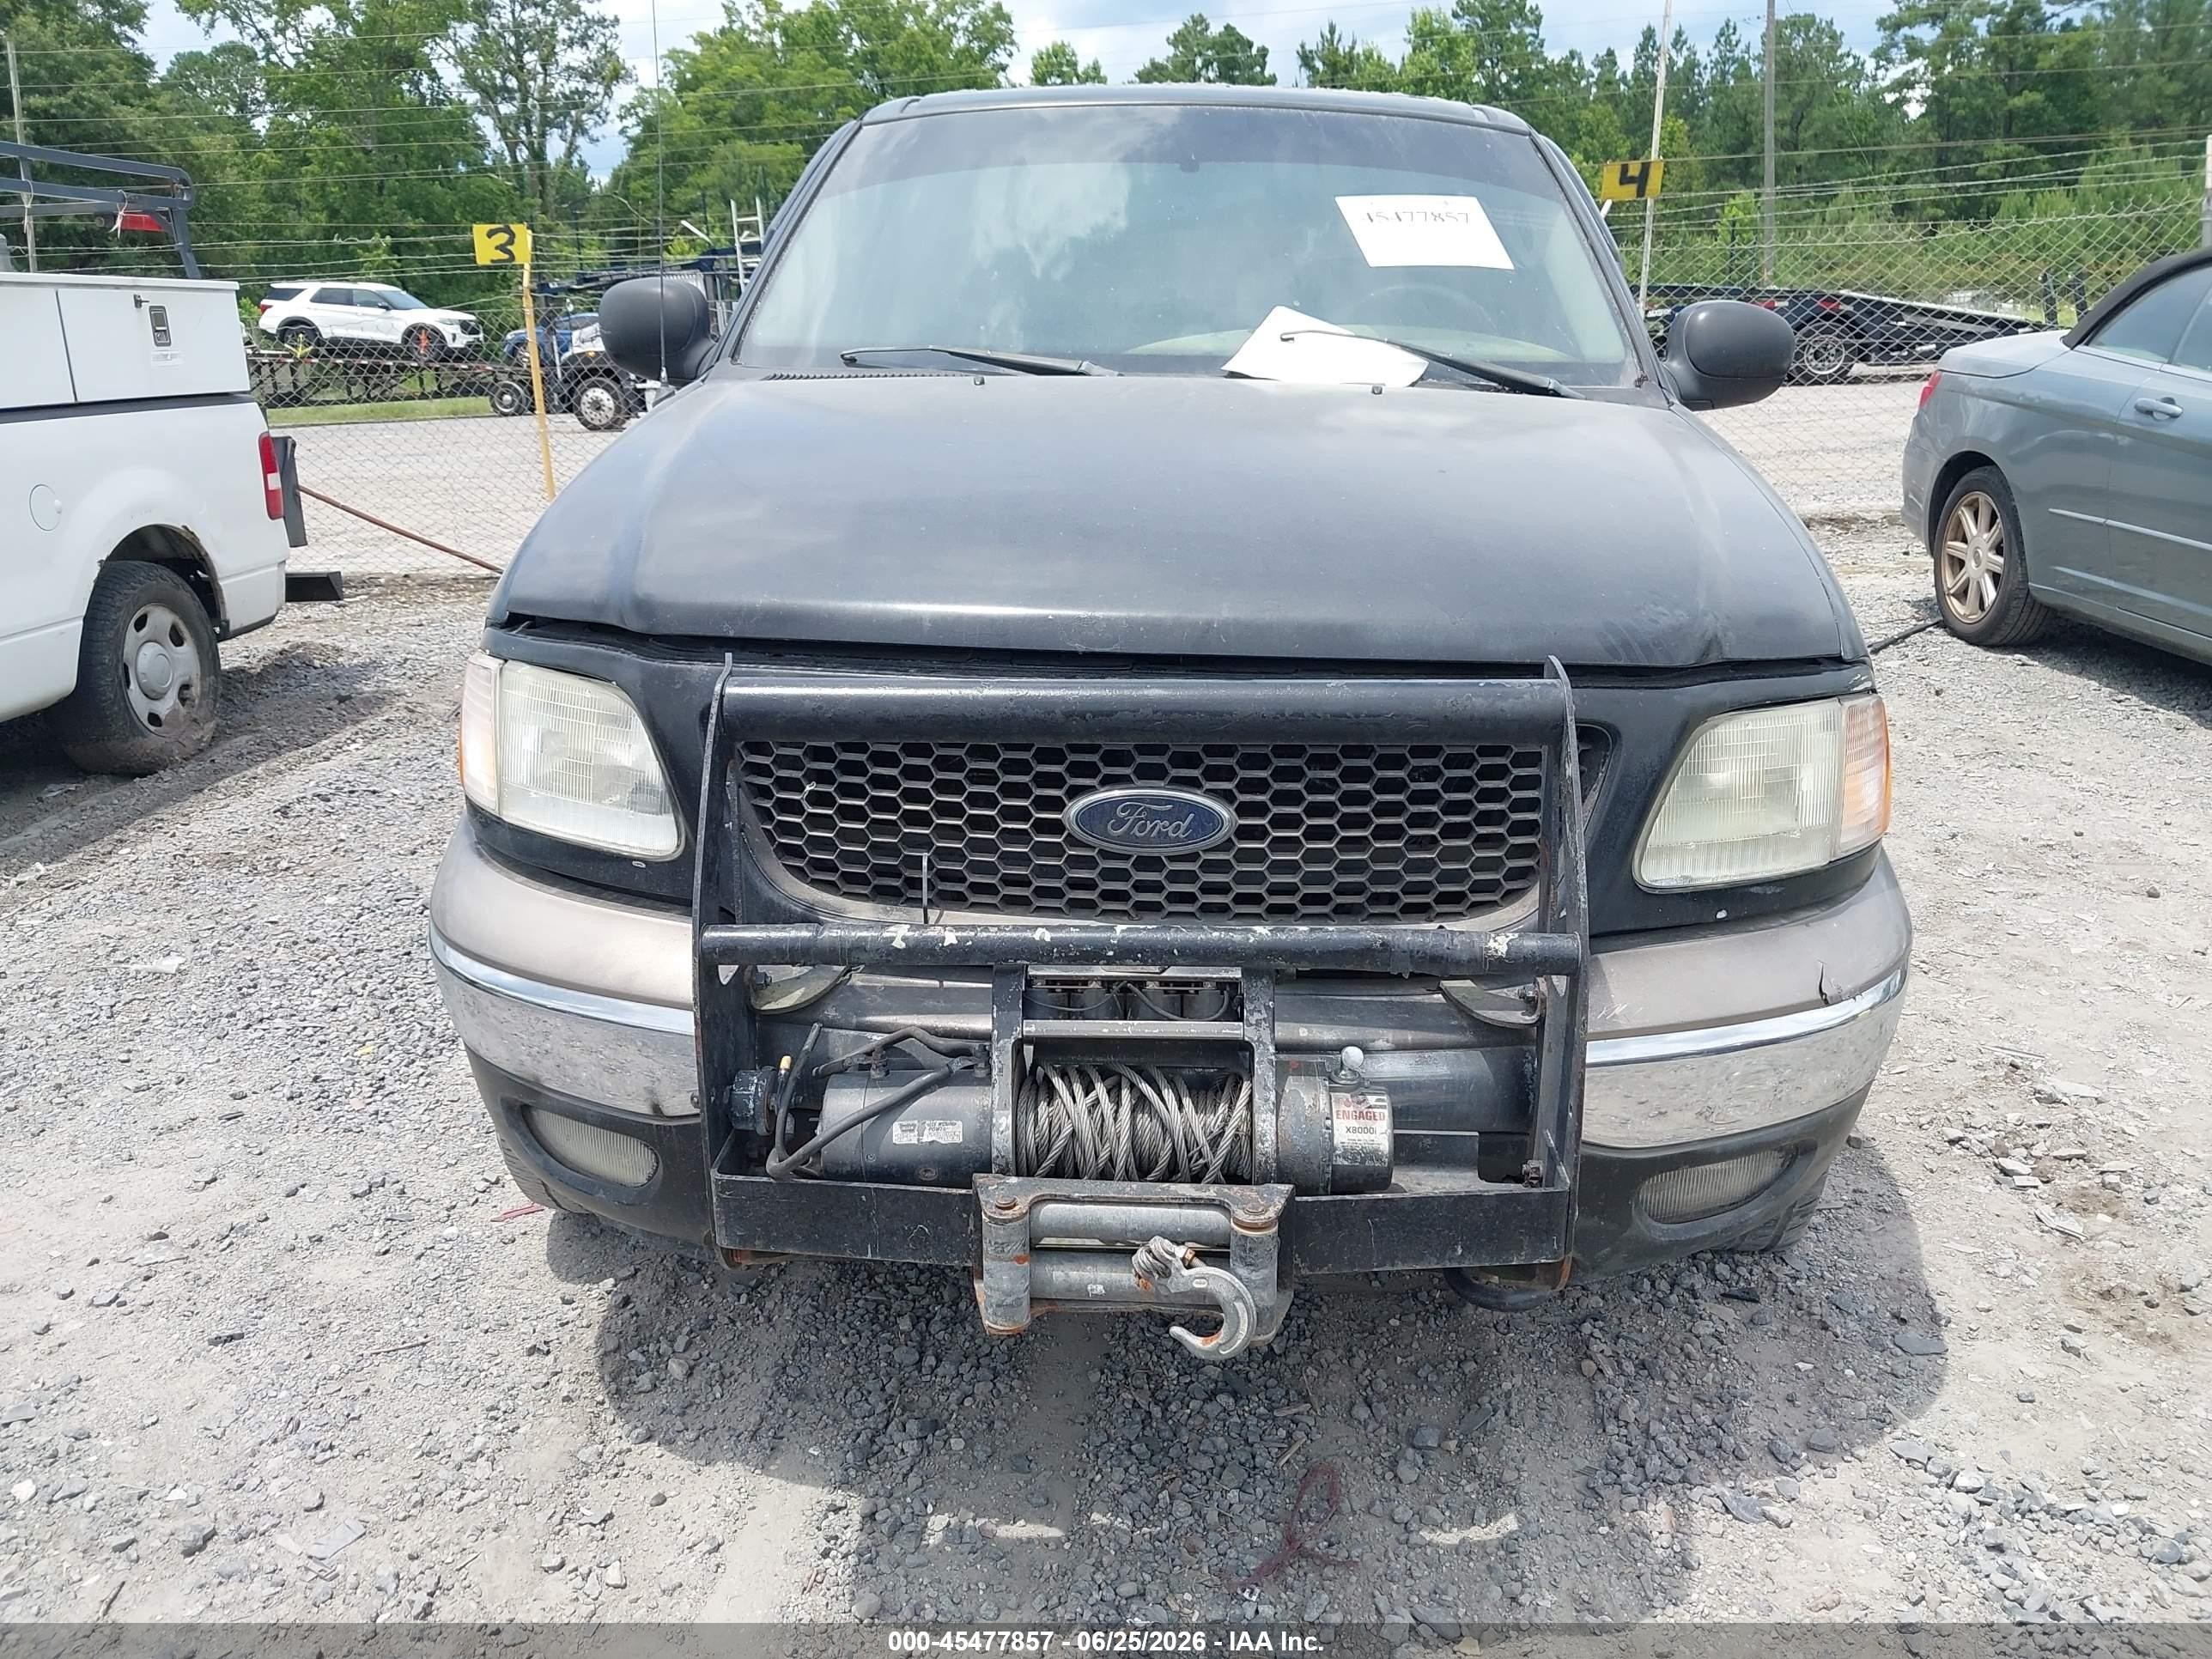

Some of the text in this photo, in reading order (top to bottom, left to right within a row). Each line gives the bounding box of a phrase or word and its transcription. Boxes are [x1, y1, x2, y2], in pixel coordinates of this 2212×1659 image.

[1620, 161, 1652, 198] 4
[486, 224, 515, 264] 3
[1107, 801, 1194, 839] Ford
[1335, 1109, 1385, 1121] ENGAGED
